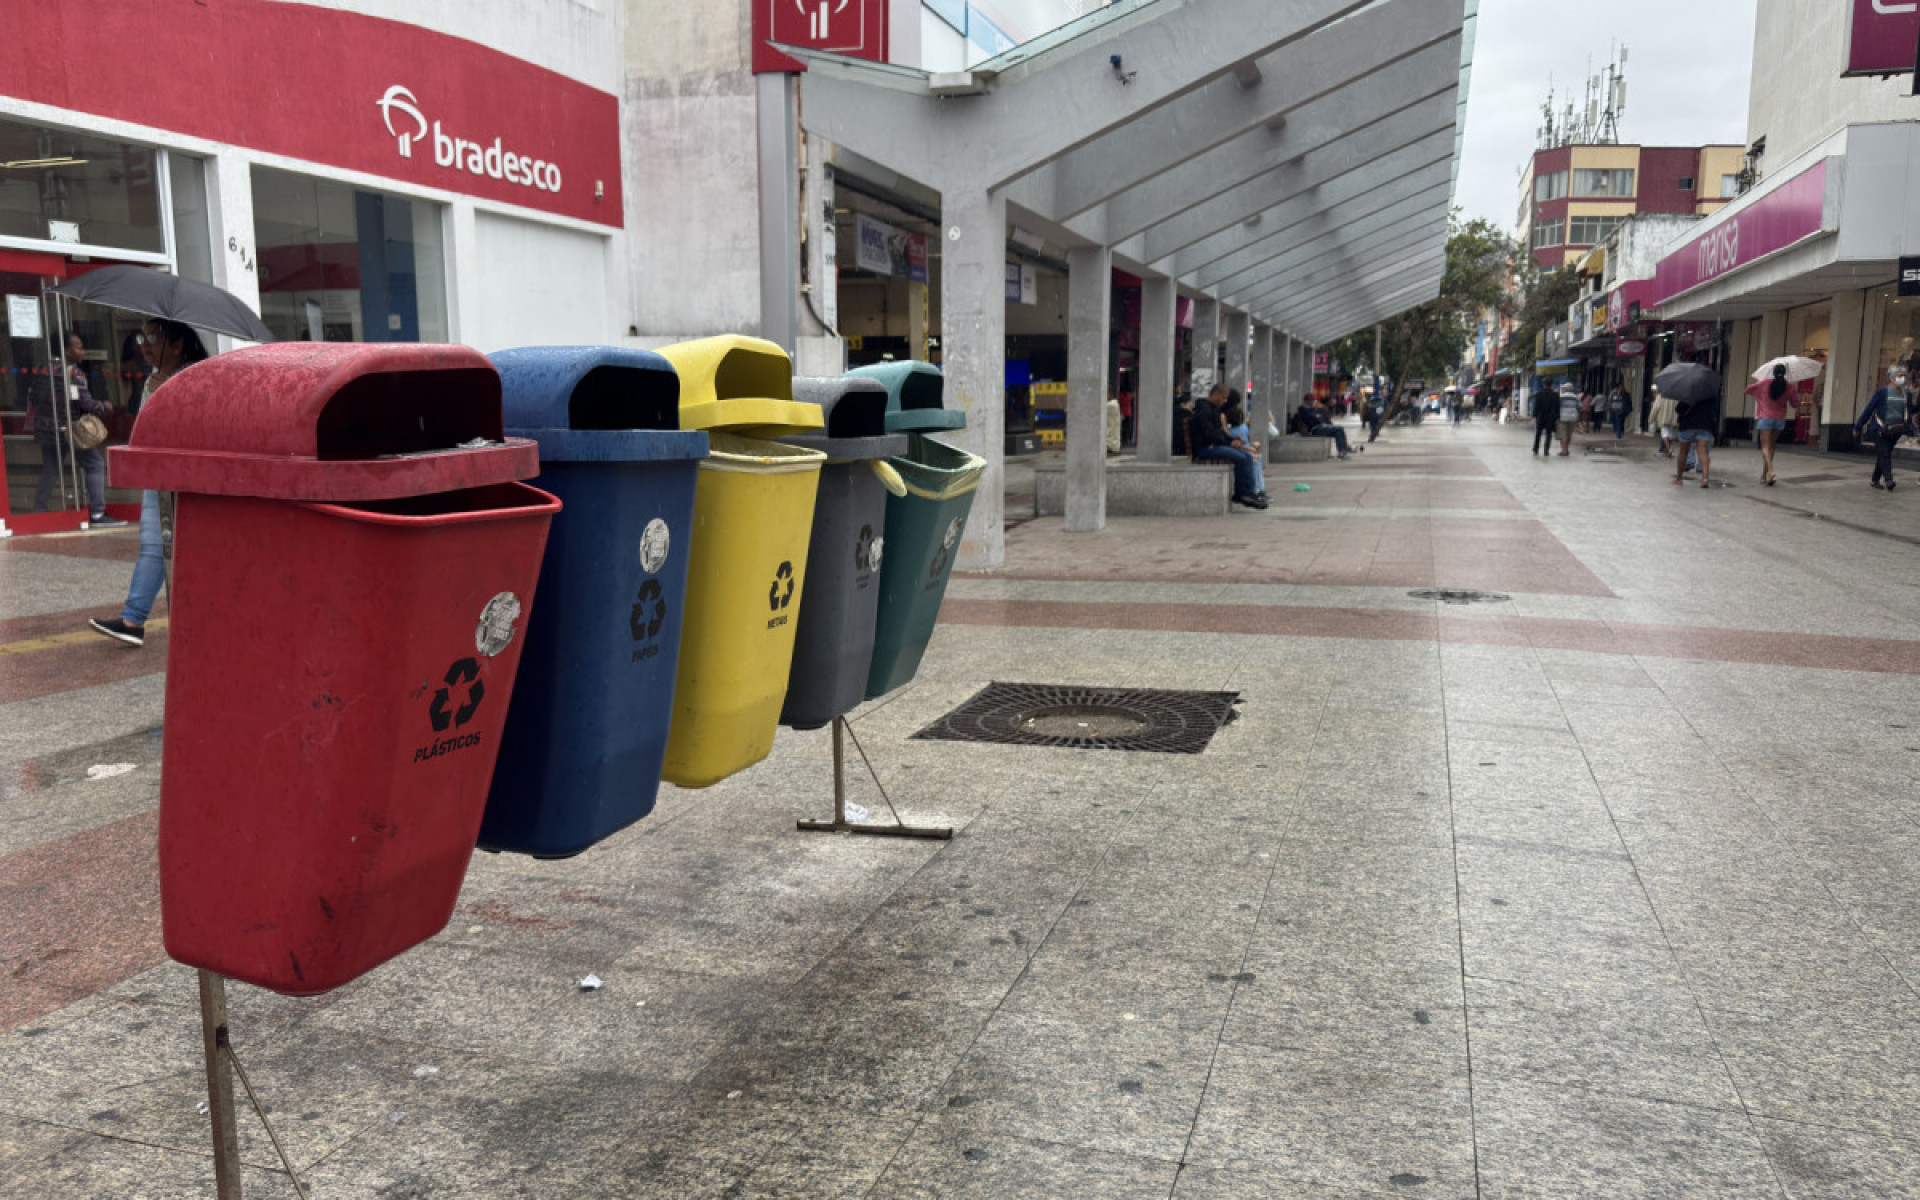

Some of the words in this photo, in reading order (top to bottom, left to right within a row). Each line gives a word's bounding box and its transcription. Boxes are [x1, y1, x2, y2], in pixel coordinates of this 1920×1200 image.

[433, 119, 562, 193] bradesco
[1697, 218, 1739, 281] marisa
[413, 730, 482, 764] PLÁSTICOS
